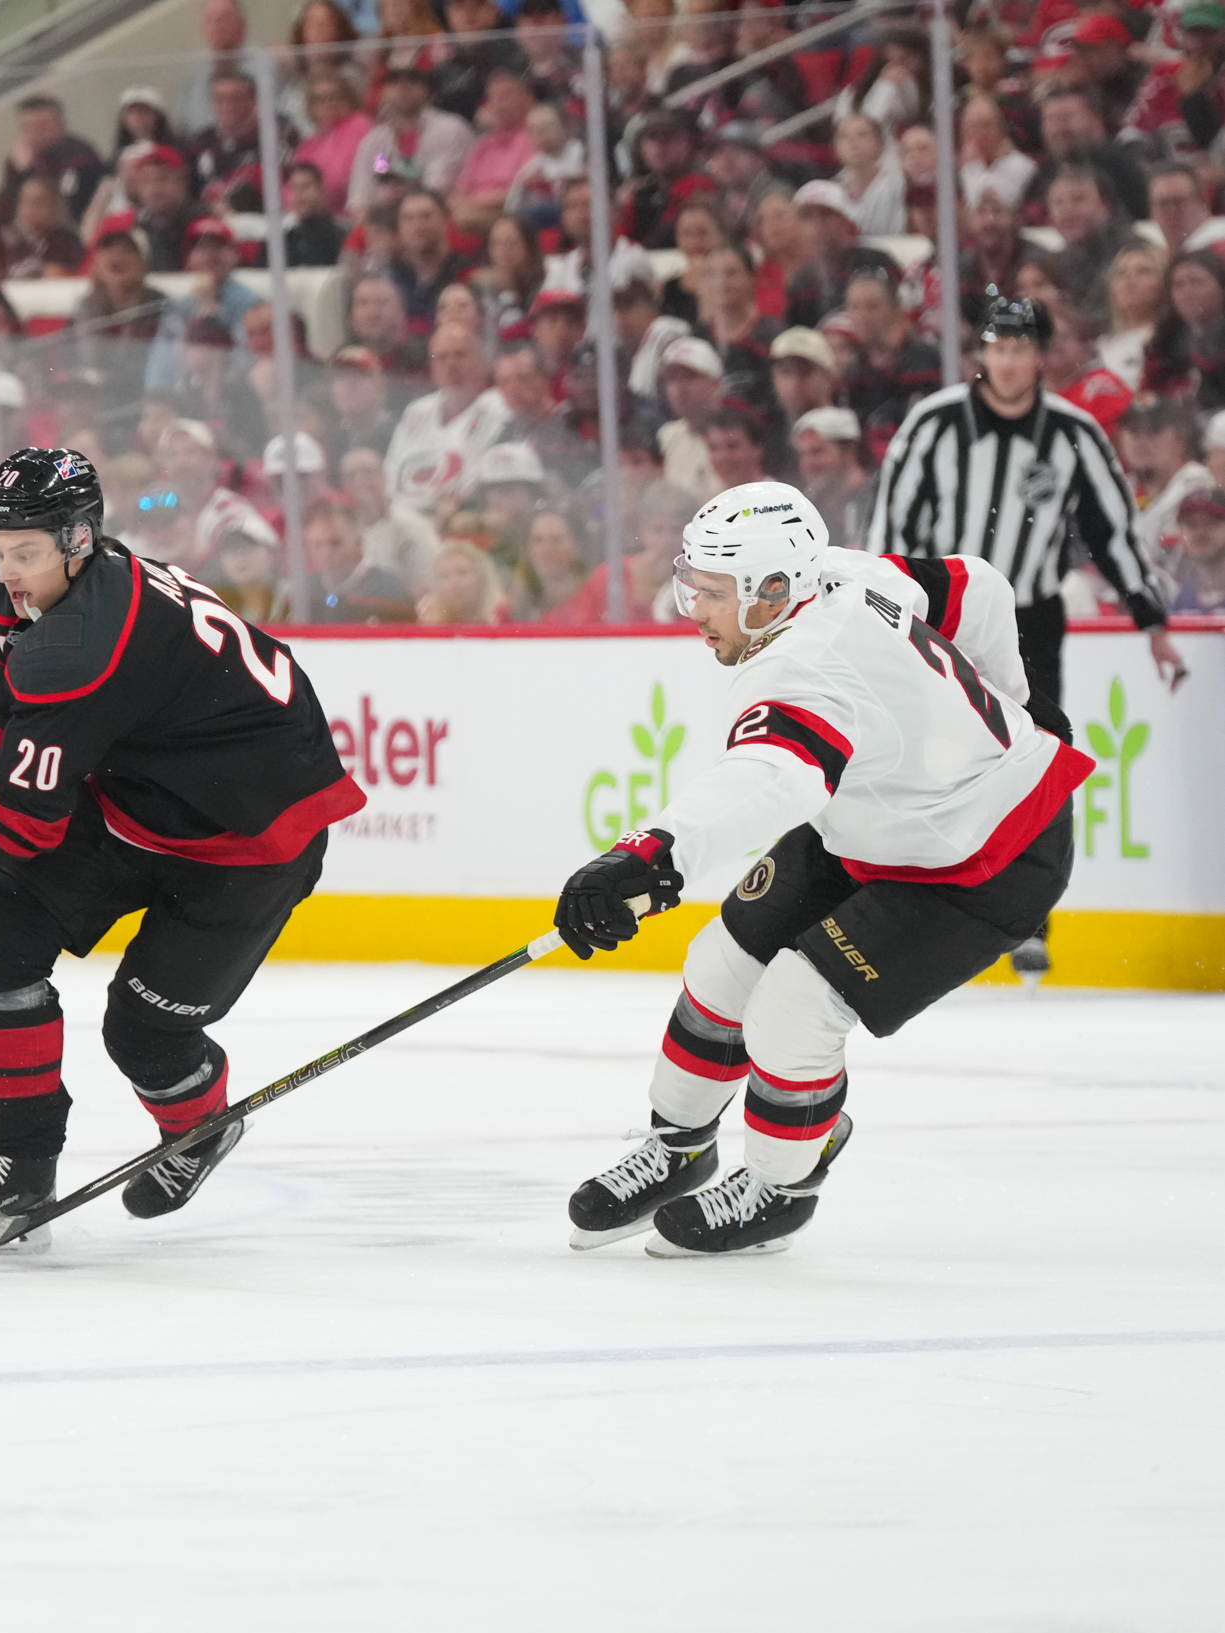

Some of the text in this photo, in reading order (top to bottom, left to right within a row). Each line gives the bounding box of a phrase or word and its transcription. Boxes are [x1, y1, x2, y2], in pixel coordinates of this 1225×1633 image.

[753, 503, 794, 515] Fullscript
[908, 614, 1012, 750] 2
[329, 695, 449, 786] eter
[733, 703, 772, 744] 2
[8, 737, 63, 792] 20
[1084, 723, 1151, 858] FL
[338, 813, 437, 841] MARKET
[820, 917, 880, 982] BAUER
[127, 977, 211, 1016] BAUER
